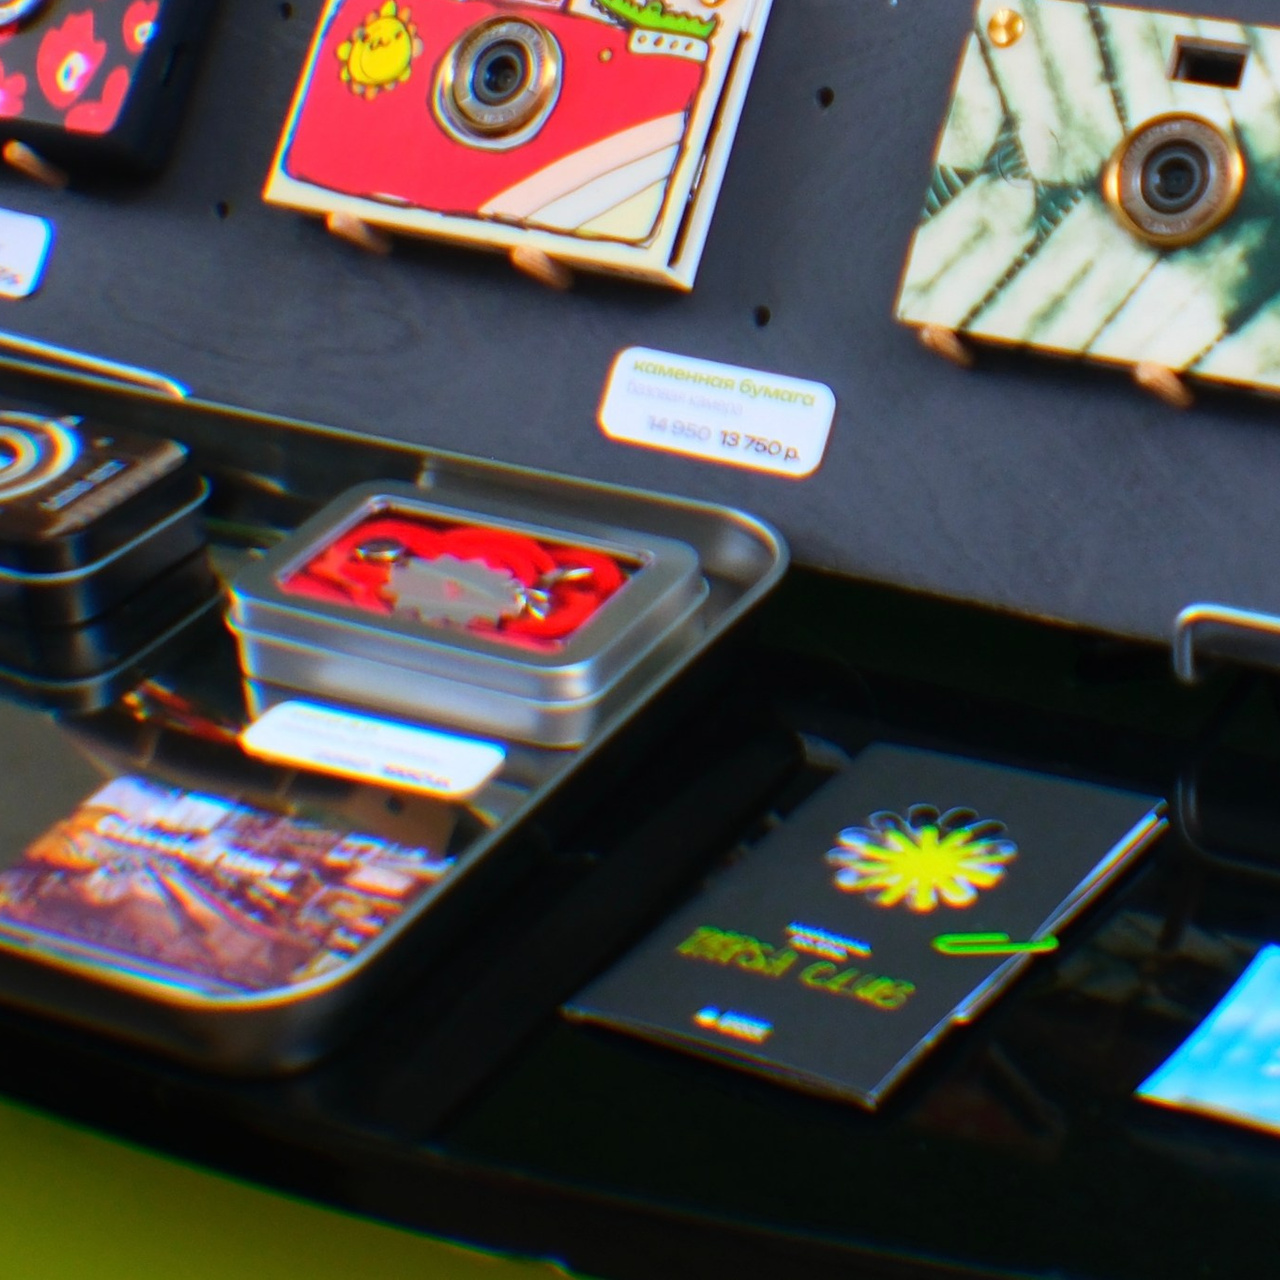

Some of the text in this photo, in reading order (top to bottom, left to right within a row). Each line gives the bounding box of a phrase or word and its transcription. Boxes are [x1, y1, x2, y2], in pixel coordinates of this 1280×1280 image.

[633, 359, 817, 407] каменная бумага
[745, 433, 782, 457] 750
